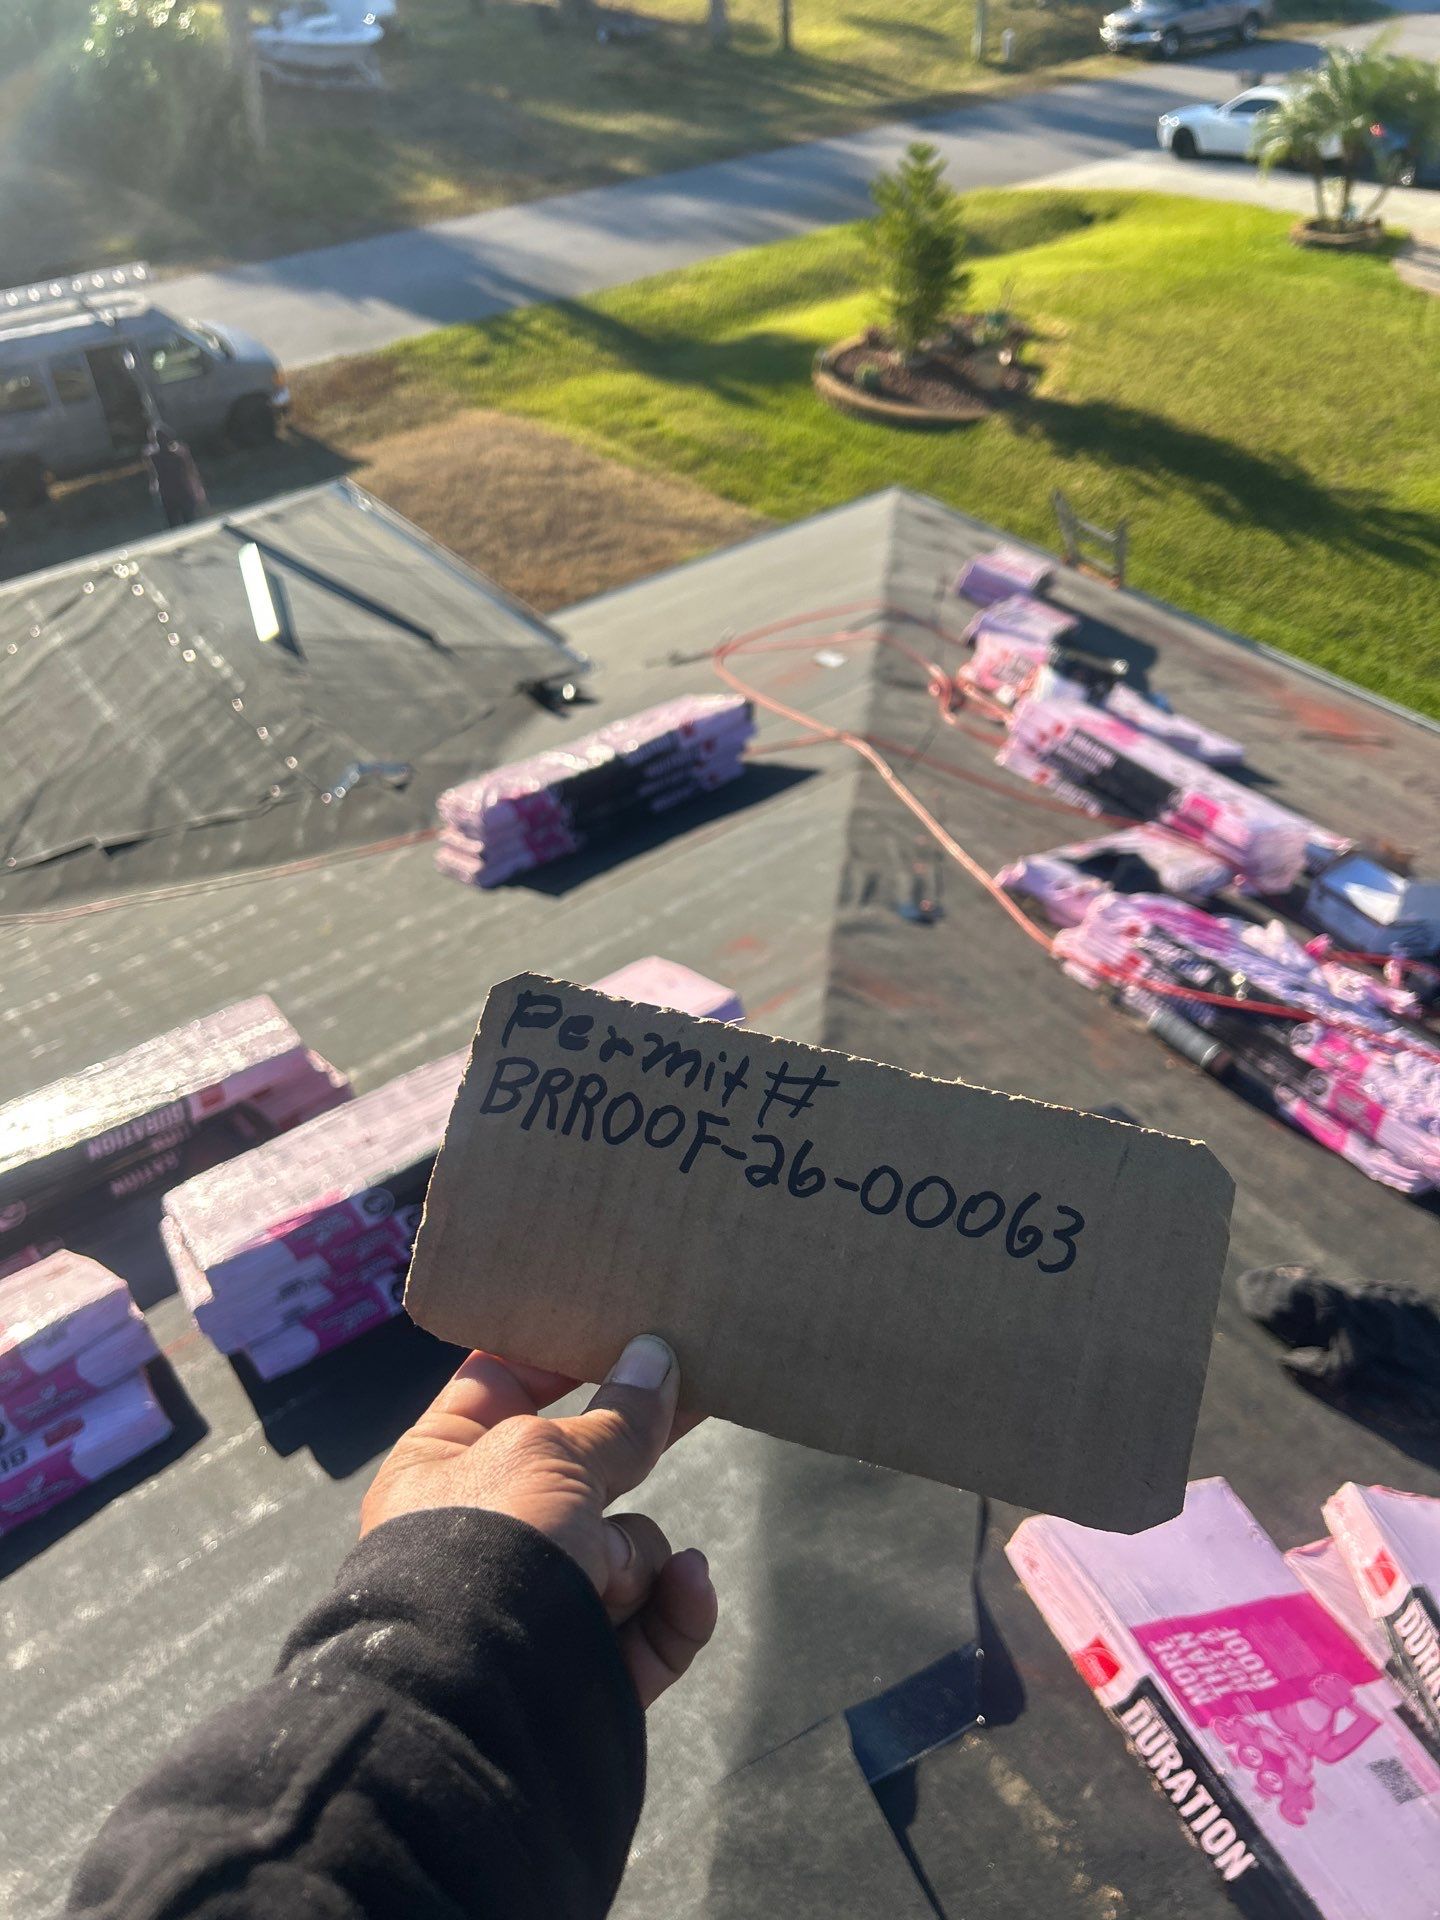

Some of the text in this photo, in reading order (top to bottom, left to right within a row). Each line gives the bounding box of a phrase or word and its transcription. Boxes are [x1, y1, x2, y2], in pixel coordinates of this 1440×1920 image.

[502, 990, 841, 1128] Permit #
[480, 1056, 1086, 1273] BRROOF-26-00063
[1148, 1639, 1223, 1706] MORE
[1173, 1631, 1236, 1694] THAN
[1217, 1627, 1281, 1692] ROOF
[1120, 1697, 1257, 1882] DURATION
